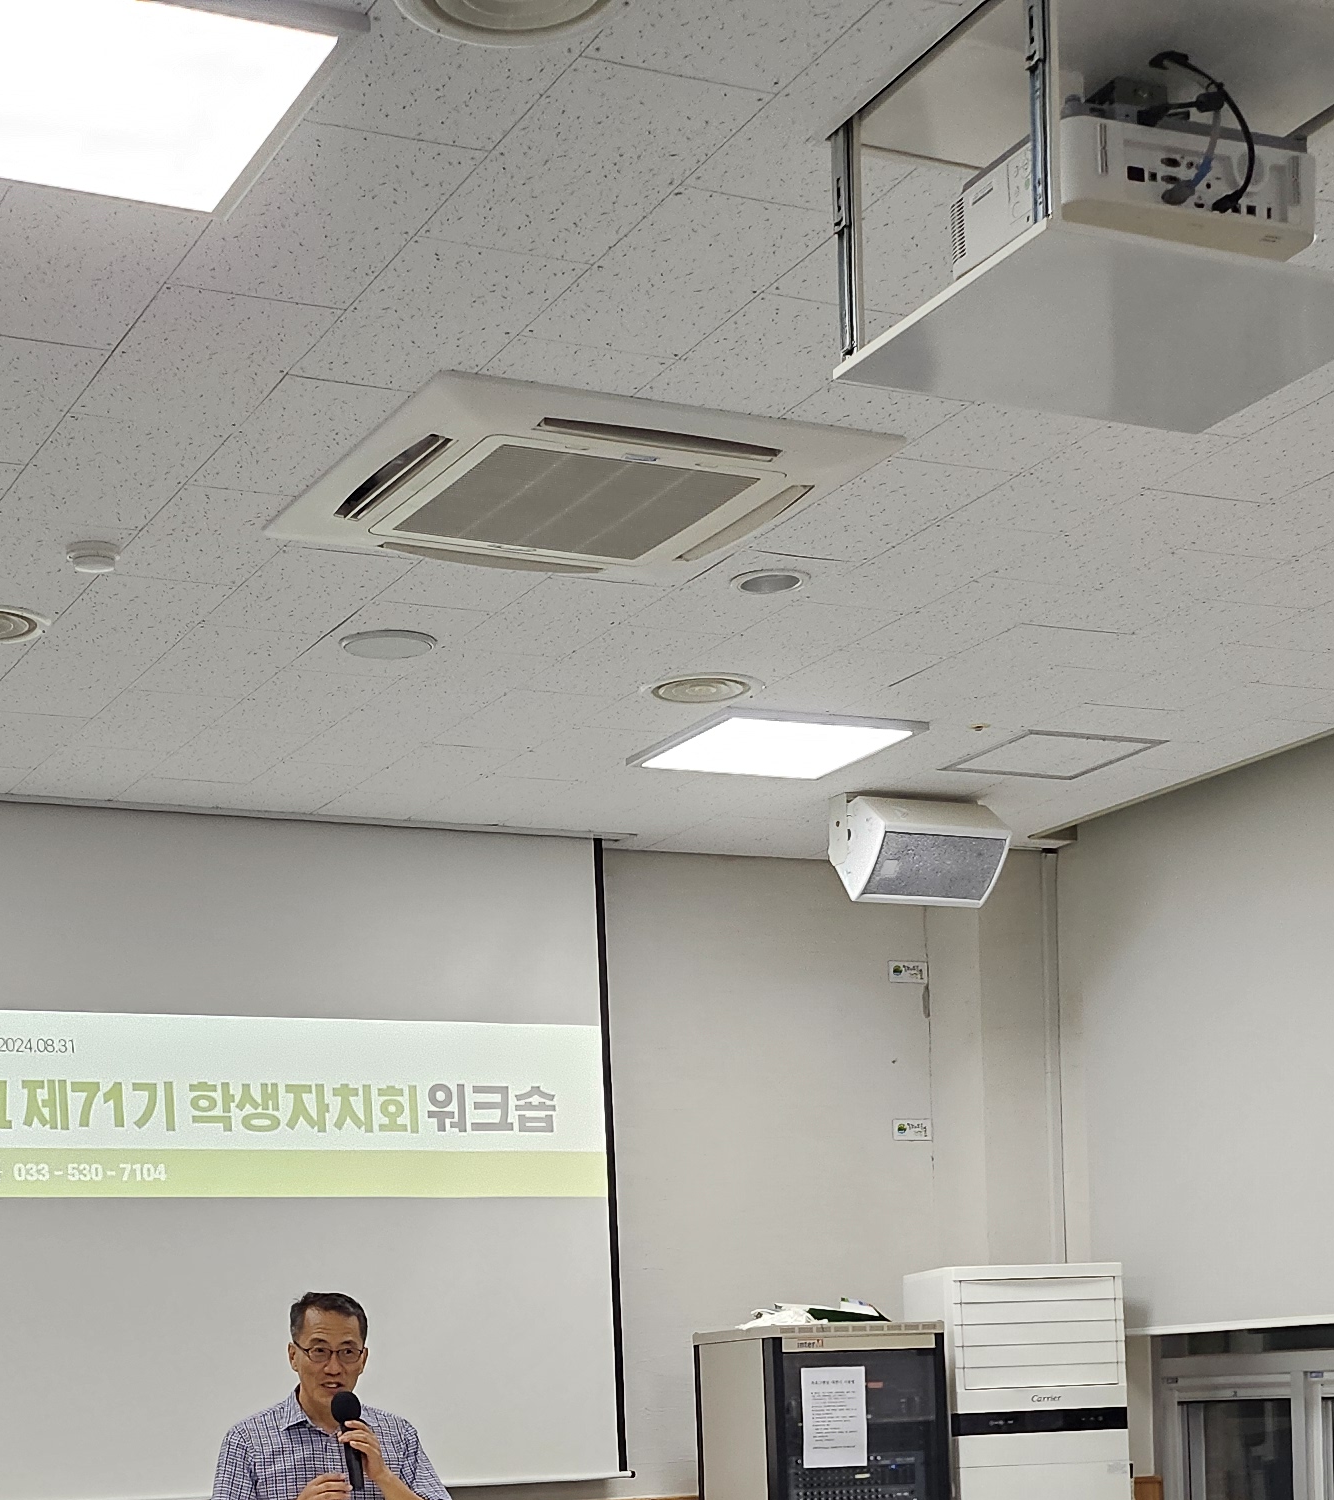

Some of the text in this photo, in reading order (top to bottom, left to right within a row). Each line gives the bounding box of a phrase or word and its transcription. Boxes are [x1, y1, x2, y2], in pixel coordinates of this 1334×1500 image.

[22, 1078, 177, 1132] 제71기
[188, 1080, 420, 1134] 학생자치회
[427, 1083, 557, 1134] 워크숍
[1031, 1394, 1062, 1403] Carrier
